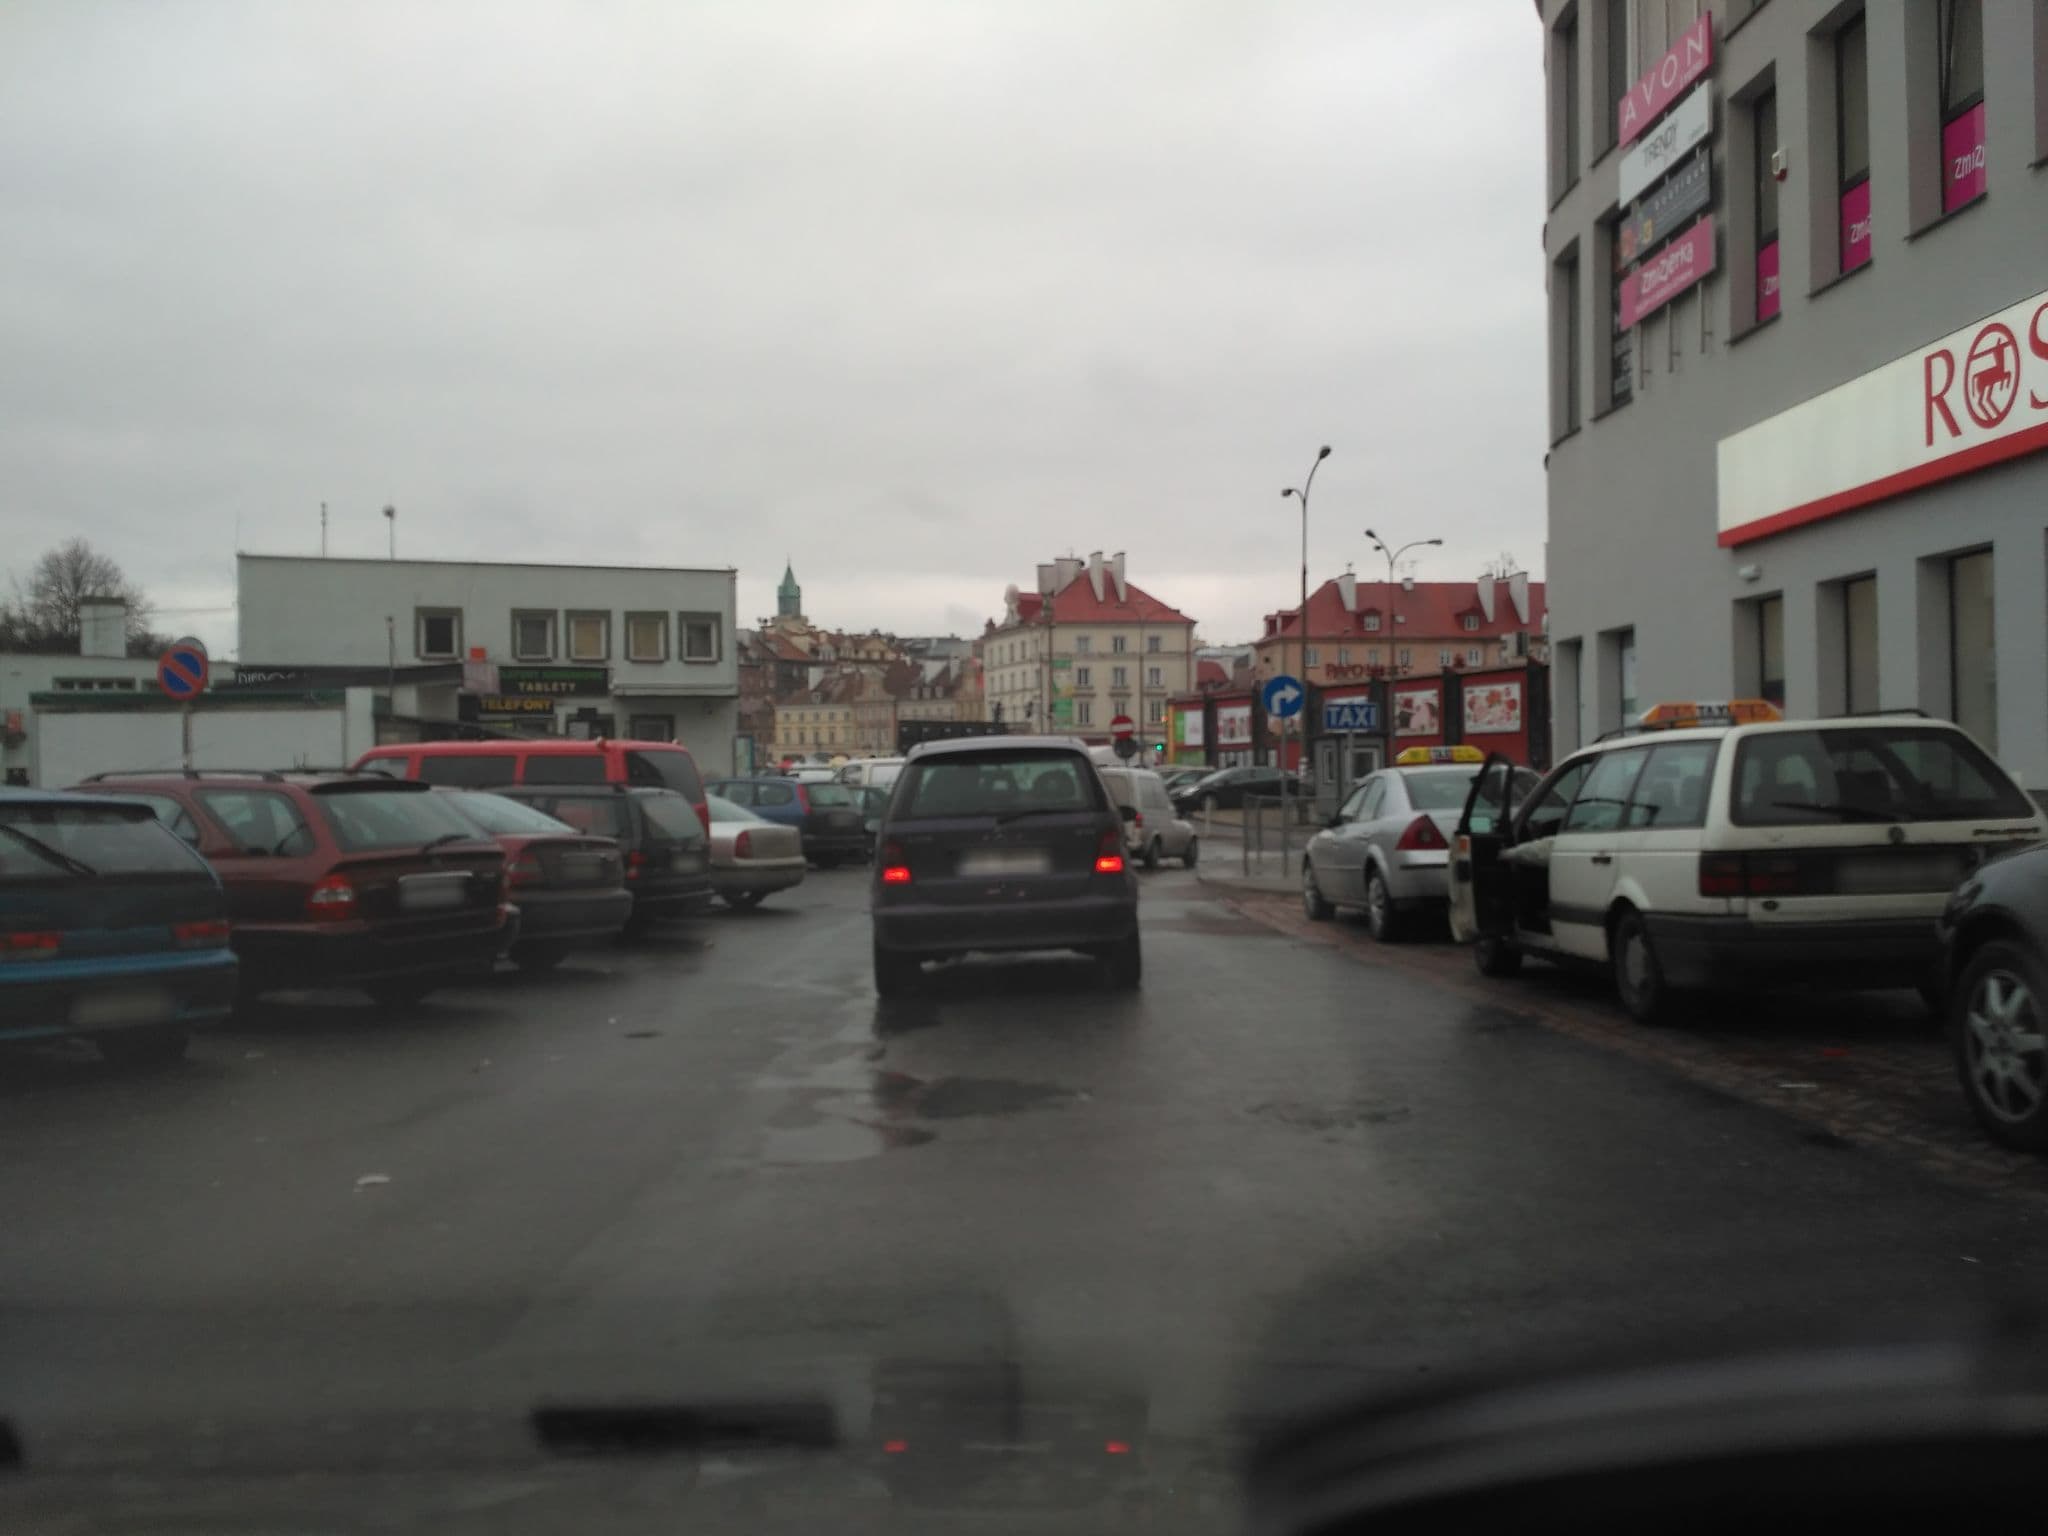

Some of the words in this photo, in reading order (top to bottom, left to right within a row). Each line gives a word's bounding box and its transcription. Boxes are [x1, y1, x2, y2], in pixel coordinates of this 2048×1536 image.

[1624, 24, 1703, 129] AVON
[518, 681, 576, 693] TABLETY
[480, 698, 552, 711] TELEFONY
[1327, 705, 1377, 727] TAXI
